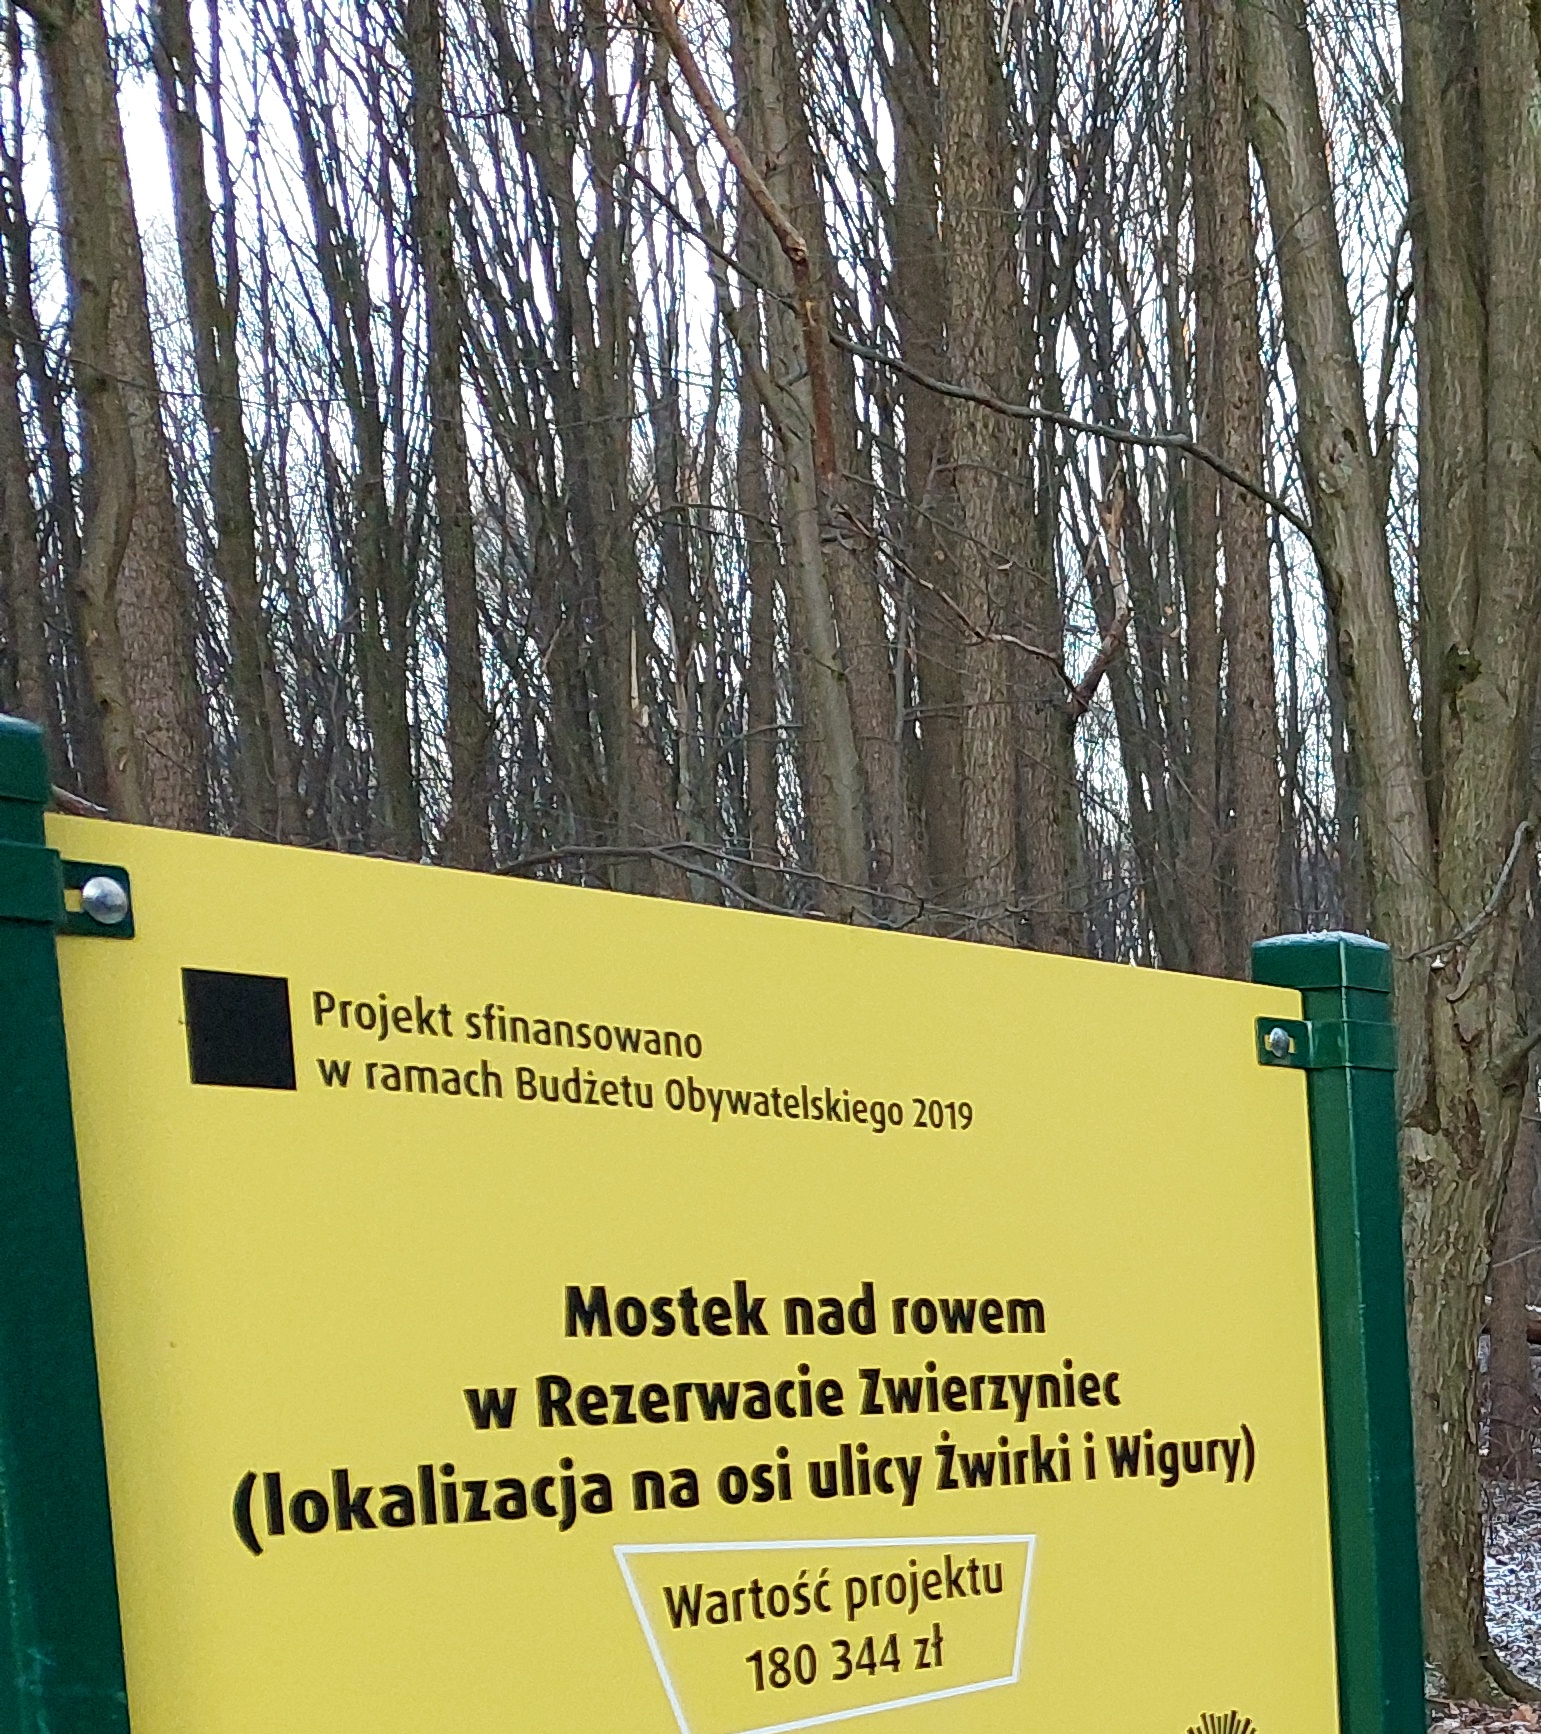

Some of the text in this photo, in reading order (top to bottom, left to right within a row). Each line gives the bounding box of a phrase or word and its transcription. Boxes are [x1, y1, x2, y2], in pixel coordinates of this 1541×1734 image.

[312, 990, 703, 1059] Projekt sfinansowano
[315, 1058, 973, 1134] w ramach Budżetu Obywatelskiego 2019
[564, 1279, 1046, 1338] Mostek nad rowem
[462, 1357, 1122, 1430] w Rezerwacie Zwierzyniec
[232, 1423, 1255, 1557] (lokalizacja na osi ulicy Żwirki i Wigury)
[662, 1553, 1003, 1629] Wartość projektu
[745, 1622, 944, 1692] 180 344 zł
